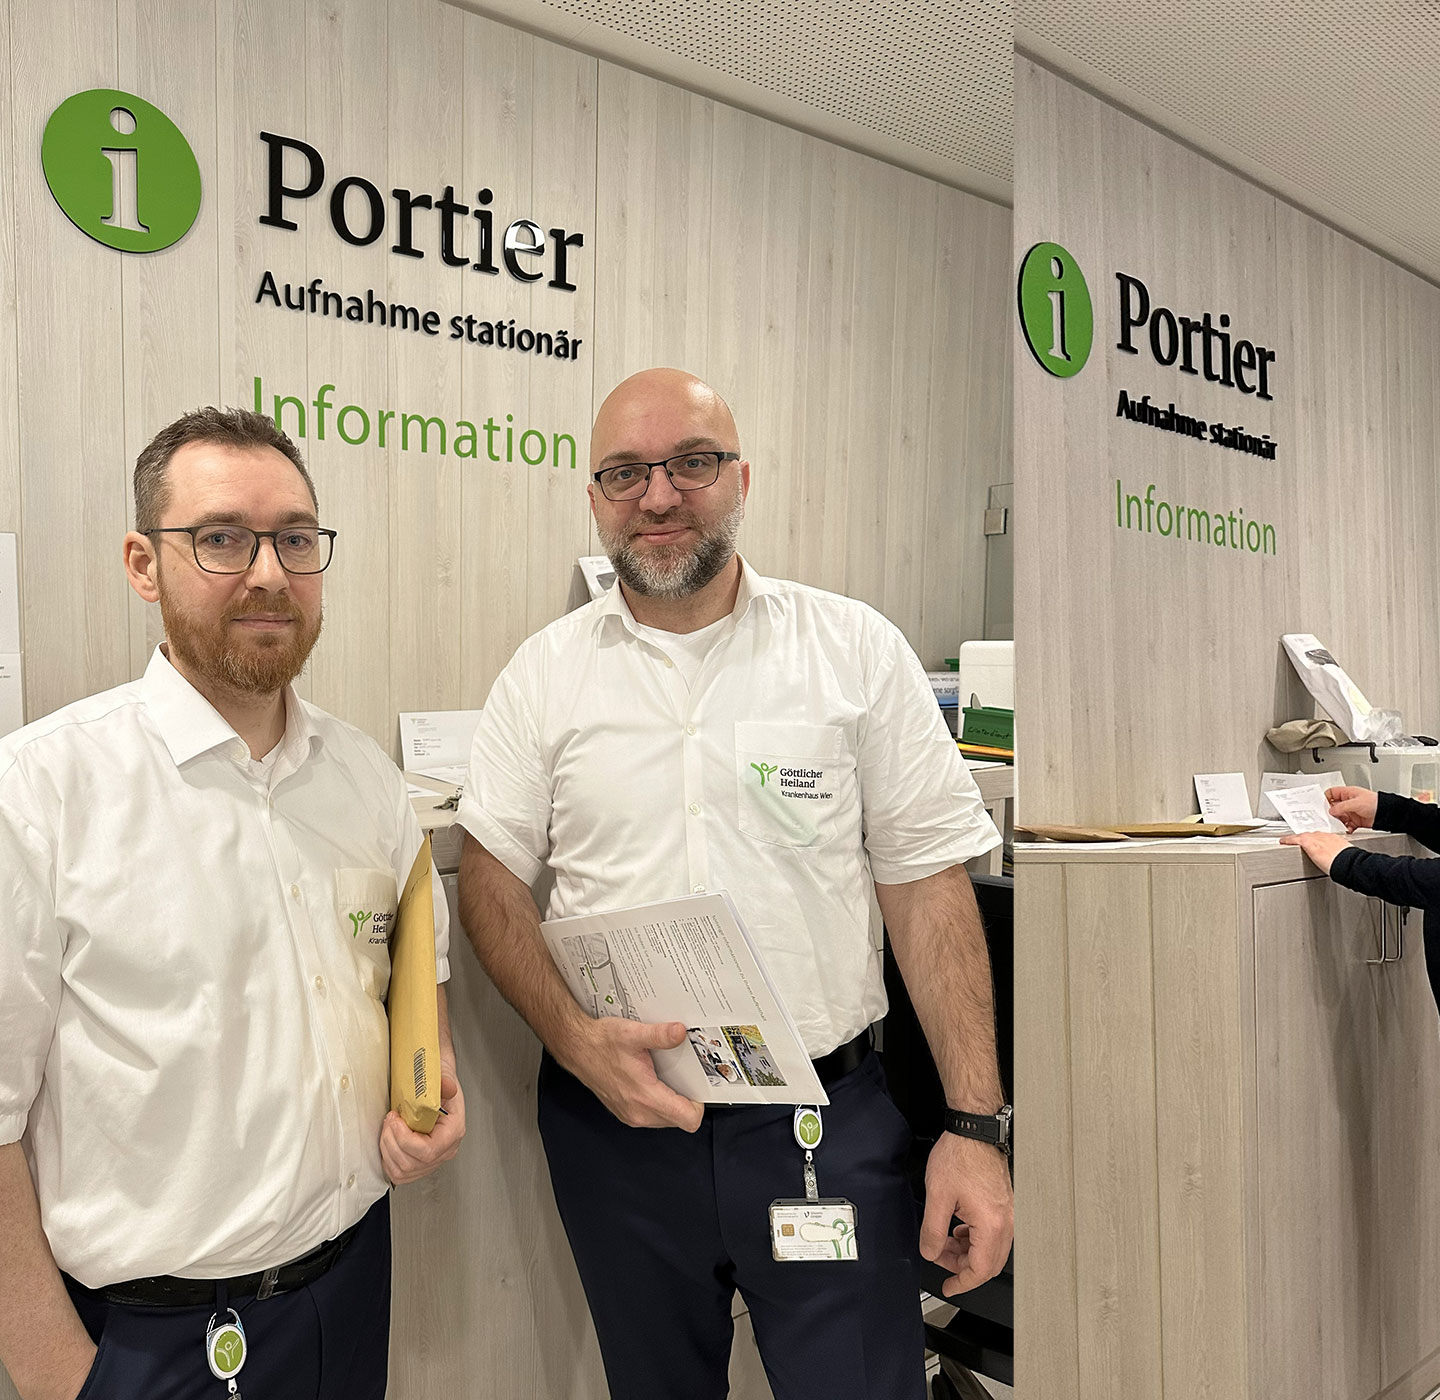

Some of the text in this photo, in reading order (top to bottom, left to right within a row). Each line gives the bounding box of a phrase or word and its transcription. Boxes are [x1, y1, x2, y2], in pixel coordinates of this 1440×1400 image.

[258, 130, 584, 292] Portier
[256, 271, 583, 361] Aufnahme stationär
[1115, 271, 1275, 401] Portier
[252, 376, 577, 469] Information
[1116, 390, 1278, 460] Aufnahme stationär
[1116, 479, 1276, 556] Information
[780, 768, 823, 779] Göttlicher
[780, 779, 815, 788] Heiland
[781, 790, 819, 800] Krankenhaus
